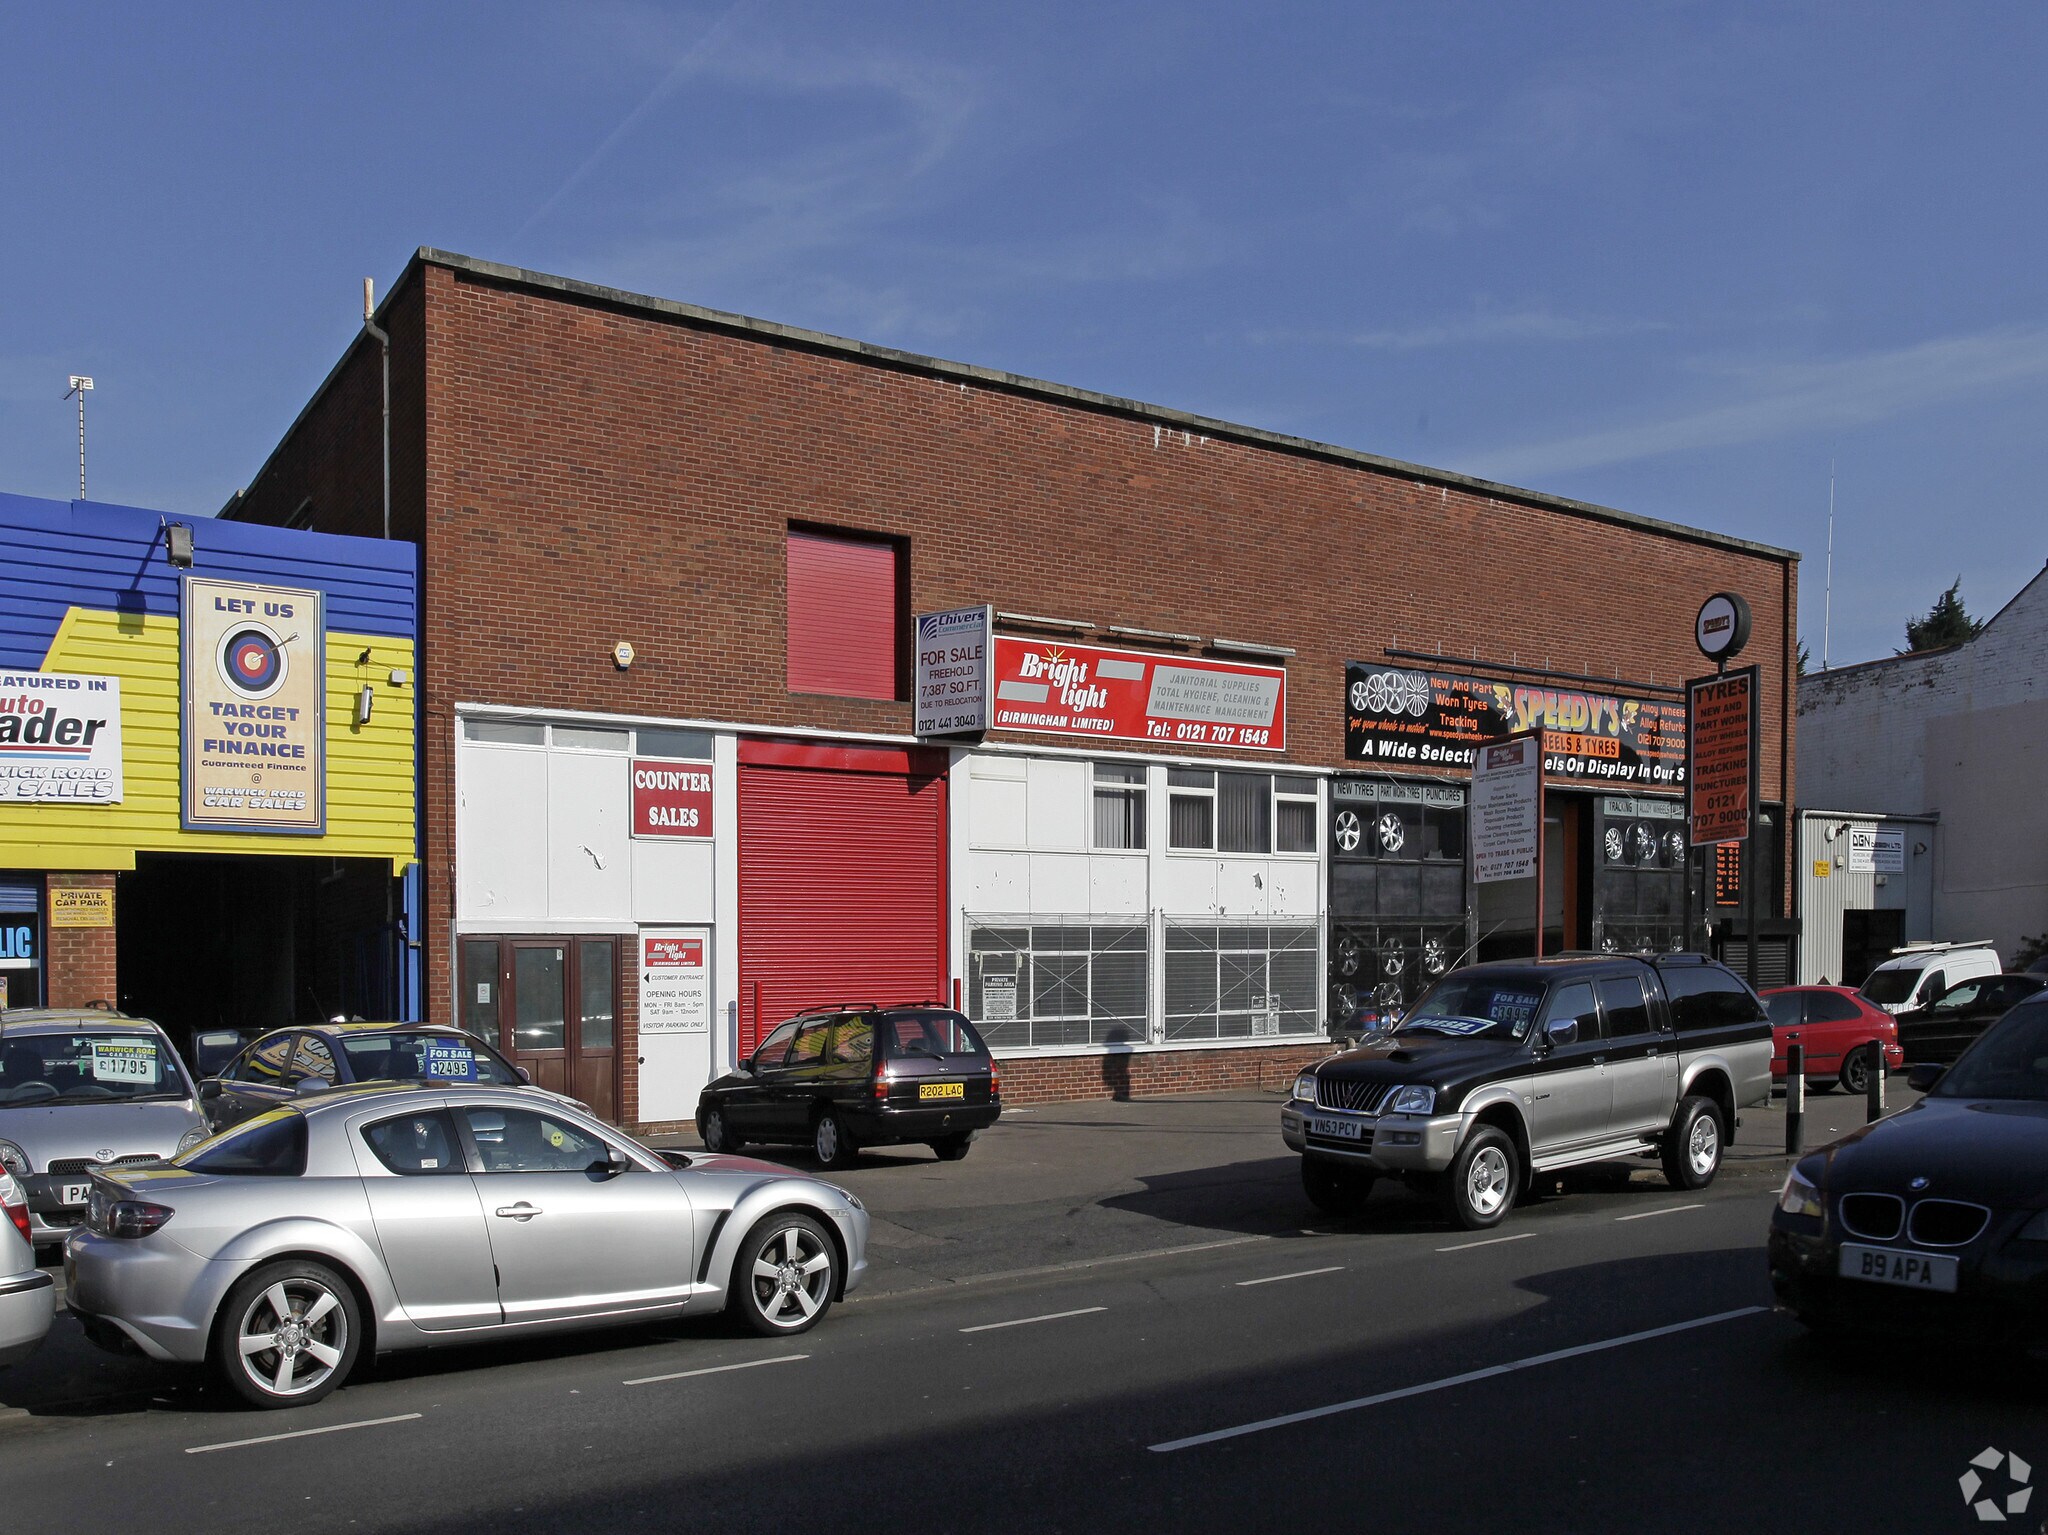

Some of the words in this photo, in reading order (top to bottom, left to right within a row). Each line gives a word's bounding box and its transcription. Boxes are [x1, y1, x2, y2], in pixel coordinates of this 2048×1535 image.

[215, 597, 256, 614] LET
[264, 602, 294, 618] US
[939, 612, 985, 625] Chivers
[939, 621, 983, 632] Commercial
[921, 650, 945, 666] FOR
[950, 645, 982, 662] SALE
[929, 666, 973, 679] FREEHOLD
[1019, 653, 1088, 687] Bright
[0, 677, 80, 690] ATURED
[88, 681, 107, 691] IN
[922, 684, 946, 697] 7,387
[950, 680, 981, 693] SQ.FT.
[1170, 674, 1218, 688] JANITORIAL
[1222, 680, 1260, 692] SUPPLIES
[1430, 678, 1448, 690] New
[1452, 681, 1468, 692] And
[1473, 683, 1492, 694] Part
[1060, 683, 1108, 712] light
[1157, 686, 1180, 698] TOTAL
[1183, 690, 1219, 702] HYGIENE,
[1224, 694, 1260, 705] CLEANING
[1264, 697, 1269, 706] &
[1694, 678, 1748, 704] TYRES
[921, 701, 932, 709] DUE
[945, 696, 982, 706] RELOCATION
[1154, 700, 1211, 714] MAINTENANCE
[1215, 707, 1268, 719] MANAGEMENT
[1435, 694, 1459, 707] Worn
[1463, 696, 1488, 712] Tyres
[1701, 705, 1720, 717] NEW
[1723, 702, 1742, 713] AND
[210, 702, 299, 721] TARGET
[1511, 685, 1620, 736] SPEEDY'S
[1641, 704, 1658, 717] Alloy
[1661, 706, 1686, 718] Wheels
[919, 719, 935, 731] 0121
[939, 717, 951, 729] 441
[955, 714, 975, 727] 3040
[998, 710, 1068, 727] (BIRMINGHAM
[1072, 717, 1114, 731] LIMITED)
[1362, 720, 1377, 733] your
[1378, 719, 1397, 731] wheels
[1399, 722, 1404, 731] in
[1440, 713, 1478, 730] Tracking
[1640, 717, 1657, 732] Alloy
[1696, 719, 1718, 732] PART
[1721, 714, 1747, 726] WORN
[224, 722, 286, 739] YOUR
[1147, 720, 1171, 737] Tel:
[1177, 723, 1207, 740] 0121
[1211, 726, 1235, 742] 707
[1240, 728, 1269, 745] 1548
[1576, 738, 1581, 752] &
[1585, 740, 1616, 755] TYRES
[1638, 734, 1651, 745] 0121
[1652, 736, 1666, 747] 707
[1666, 737, 1685, 748] 9000
[1696, 735, 1718, 744] ALLOY
[204, 739, 305, 759] FINANCE
[1362, 739, 1373, 755] A
[1379, 740, 1416, 758] Wide
[1696, 749, 1716, 759] ALLOY
[202, 760, 263, 769] Guaranteed
[267, 763, 306, 771] Finance
[1566, 757, 1584, 772] On
[1588, 760, 1636, 779] Display
[1638, 763, 1650, 778] In
[1653, 765, 1675, 780] Our
[1696, 759, 1747, 776] TRACKING
[52, 767, 112, 780] ROAD
[252, 773, 261, 784] @
[635, 770, 711, 792] COUNTER
[17, 780, 113, 797] SALES
[1337, 783, 1352, 794] NEW
[1354, 784, 1373, 796] TYRES
[1695, 776, 1747, 792] PUNCTURES
[204, 787, 267, 796] WARWICK
[270, 789, 305, 798] ROAD
[1380, 786, 1391, 797] PART
[1407, 787, 1420, 799] TYRES
[1426, 789, 1460, 801] PUNCTURES
[204, 796, 244, 808] CAR
[249, 798, 307, 810] SALES
[1609, 801, 1632, 812] TRACKING
[1708, 794, 1735, 809] 0121
[649, 806, 699, 827] SALES
[1694, 814, 1715, 827] 707
[1719, 808, 1747, 823] 9000
[1853, 834, 1870, 847] DGN
[60, 892, 102, 900] PRIVATE
[654, 943, 679, 953] Bright
[669, 951, 686, 960] light
[1494, 993, 1513, 1002] FOR
[1515, 995, 1540, 1005] SALE
[1408, 1019, 1476, 1031] DIESEL
[430, 1050, 448, 1058] FOR
[100, 1059, 147, 1074] £1795
[431, 1061, 467, 1074] £2495
[920, 1086, 943, 1096] R202
[946, 1085, 962, 1095] LAC
[1339, 1122, 1357, 1136] PCY
[1862, 1252, 1887, 1277] B9
[1892, 1257, 1931, 1284] APA
